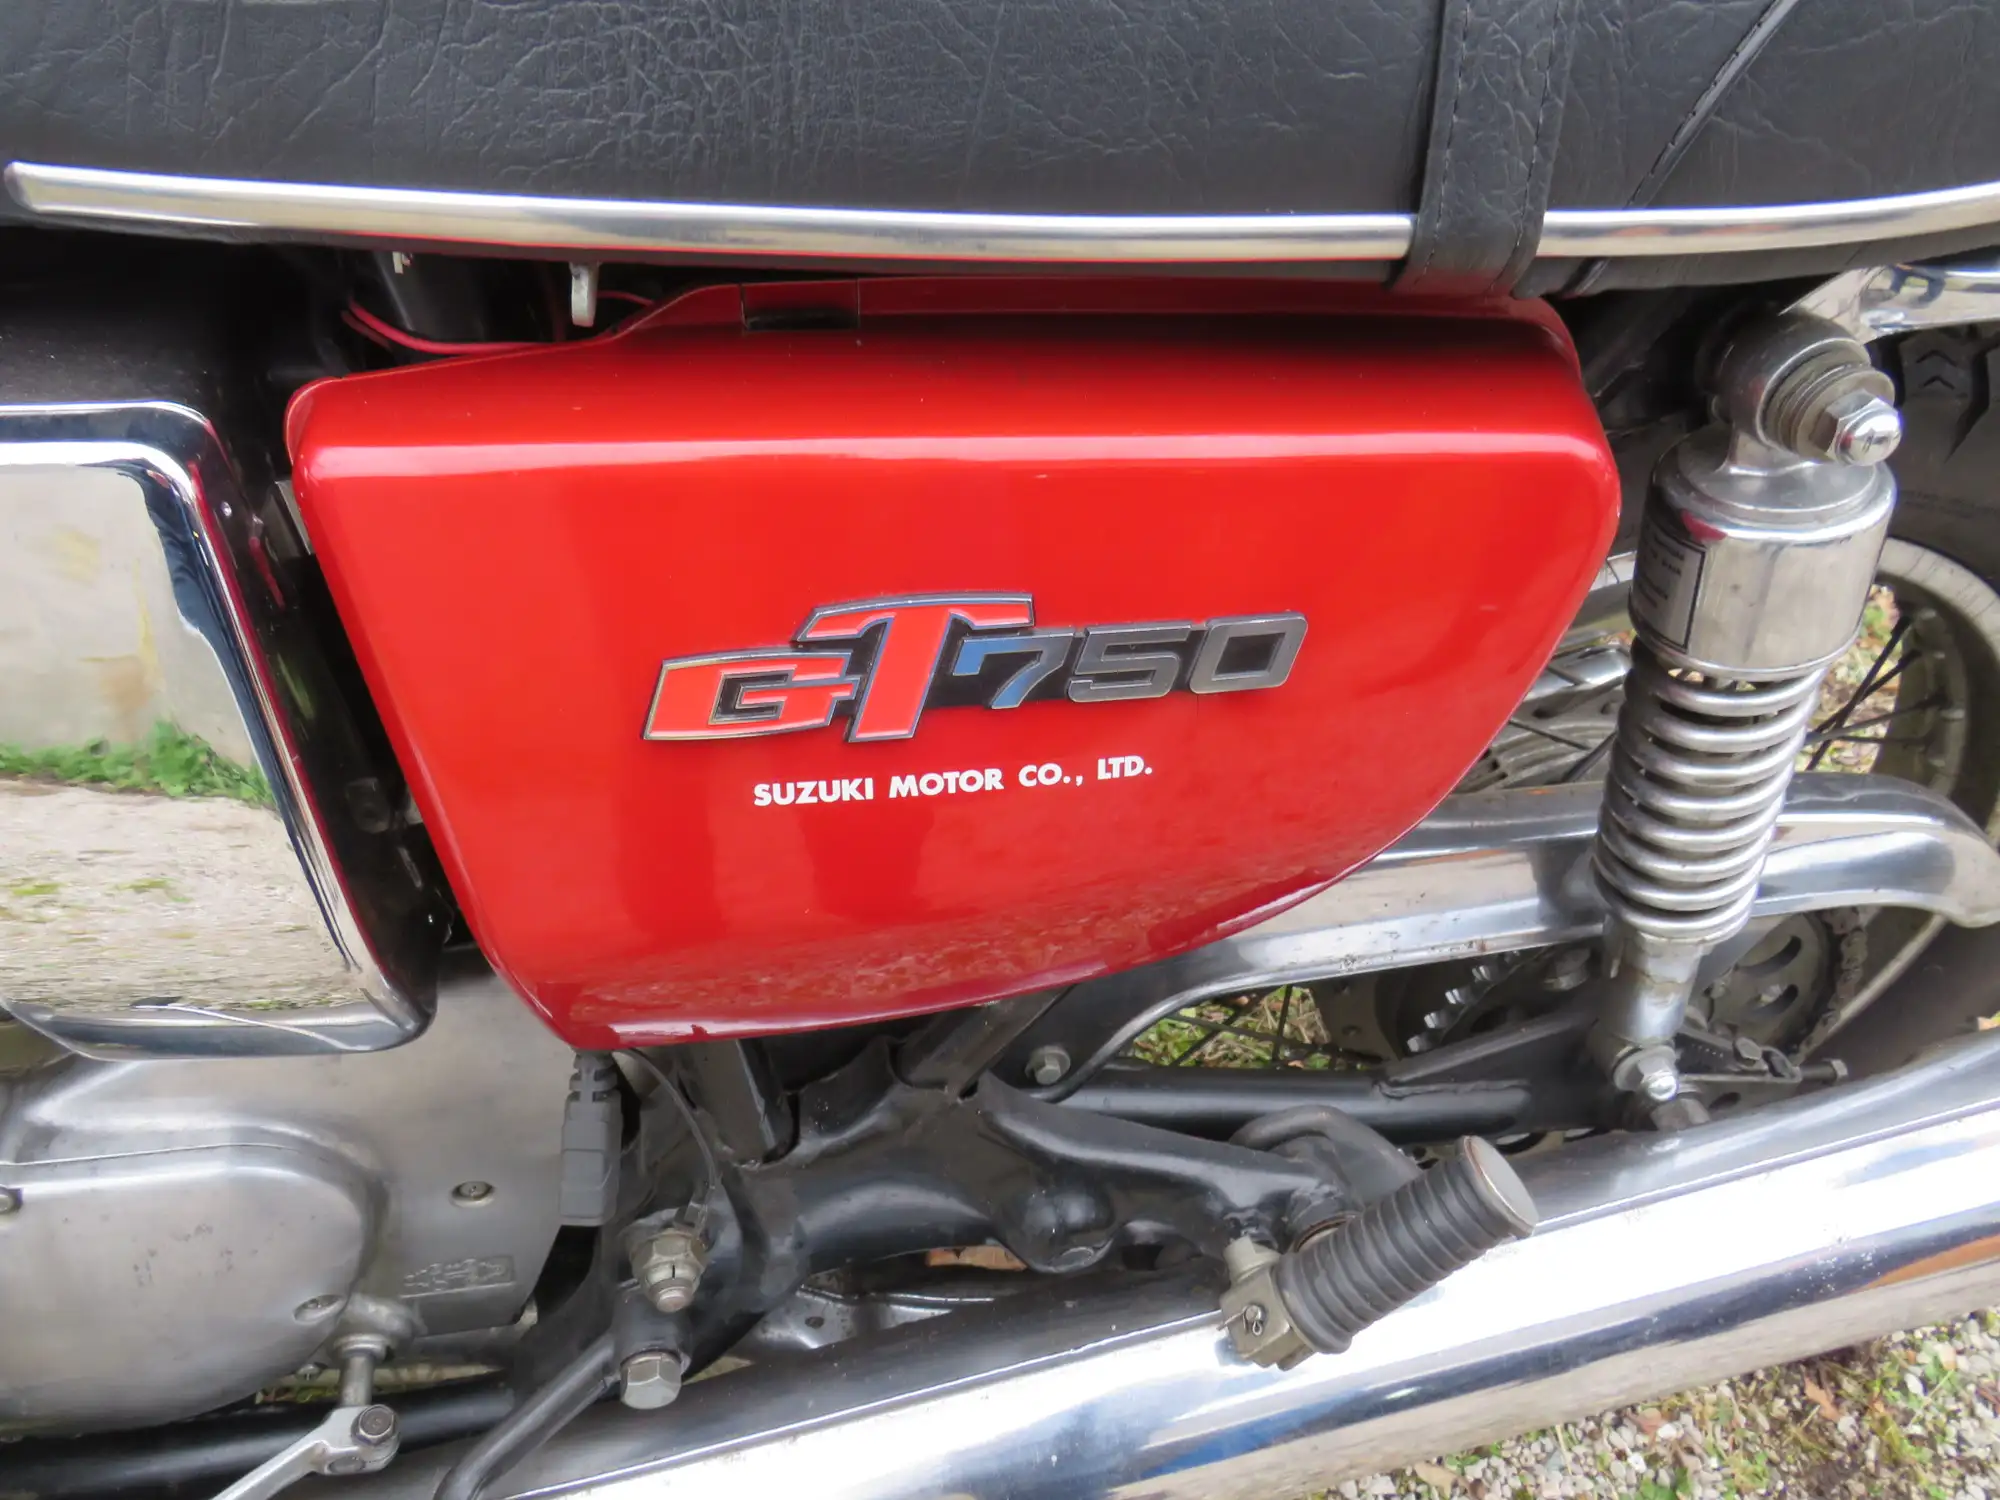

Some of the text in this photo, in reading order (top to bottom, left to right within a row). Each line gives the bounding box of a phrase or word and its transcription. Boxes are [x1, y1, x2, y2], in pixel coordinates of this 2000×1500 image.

[753, 755, 1153, 807] SUZUKI MOTOR CO., LTD.
